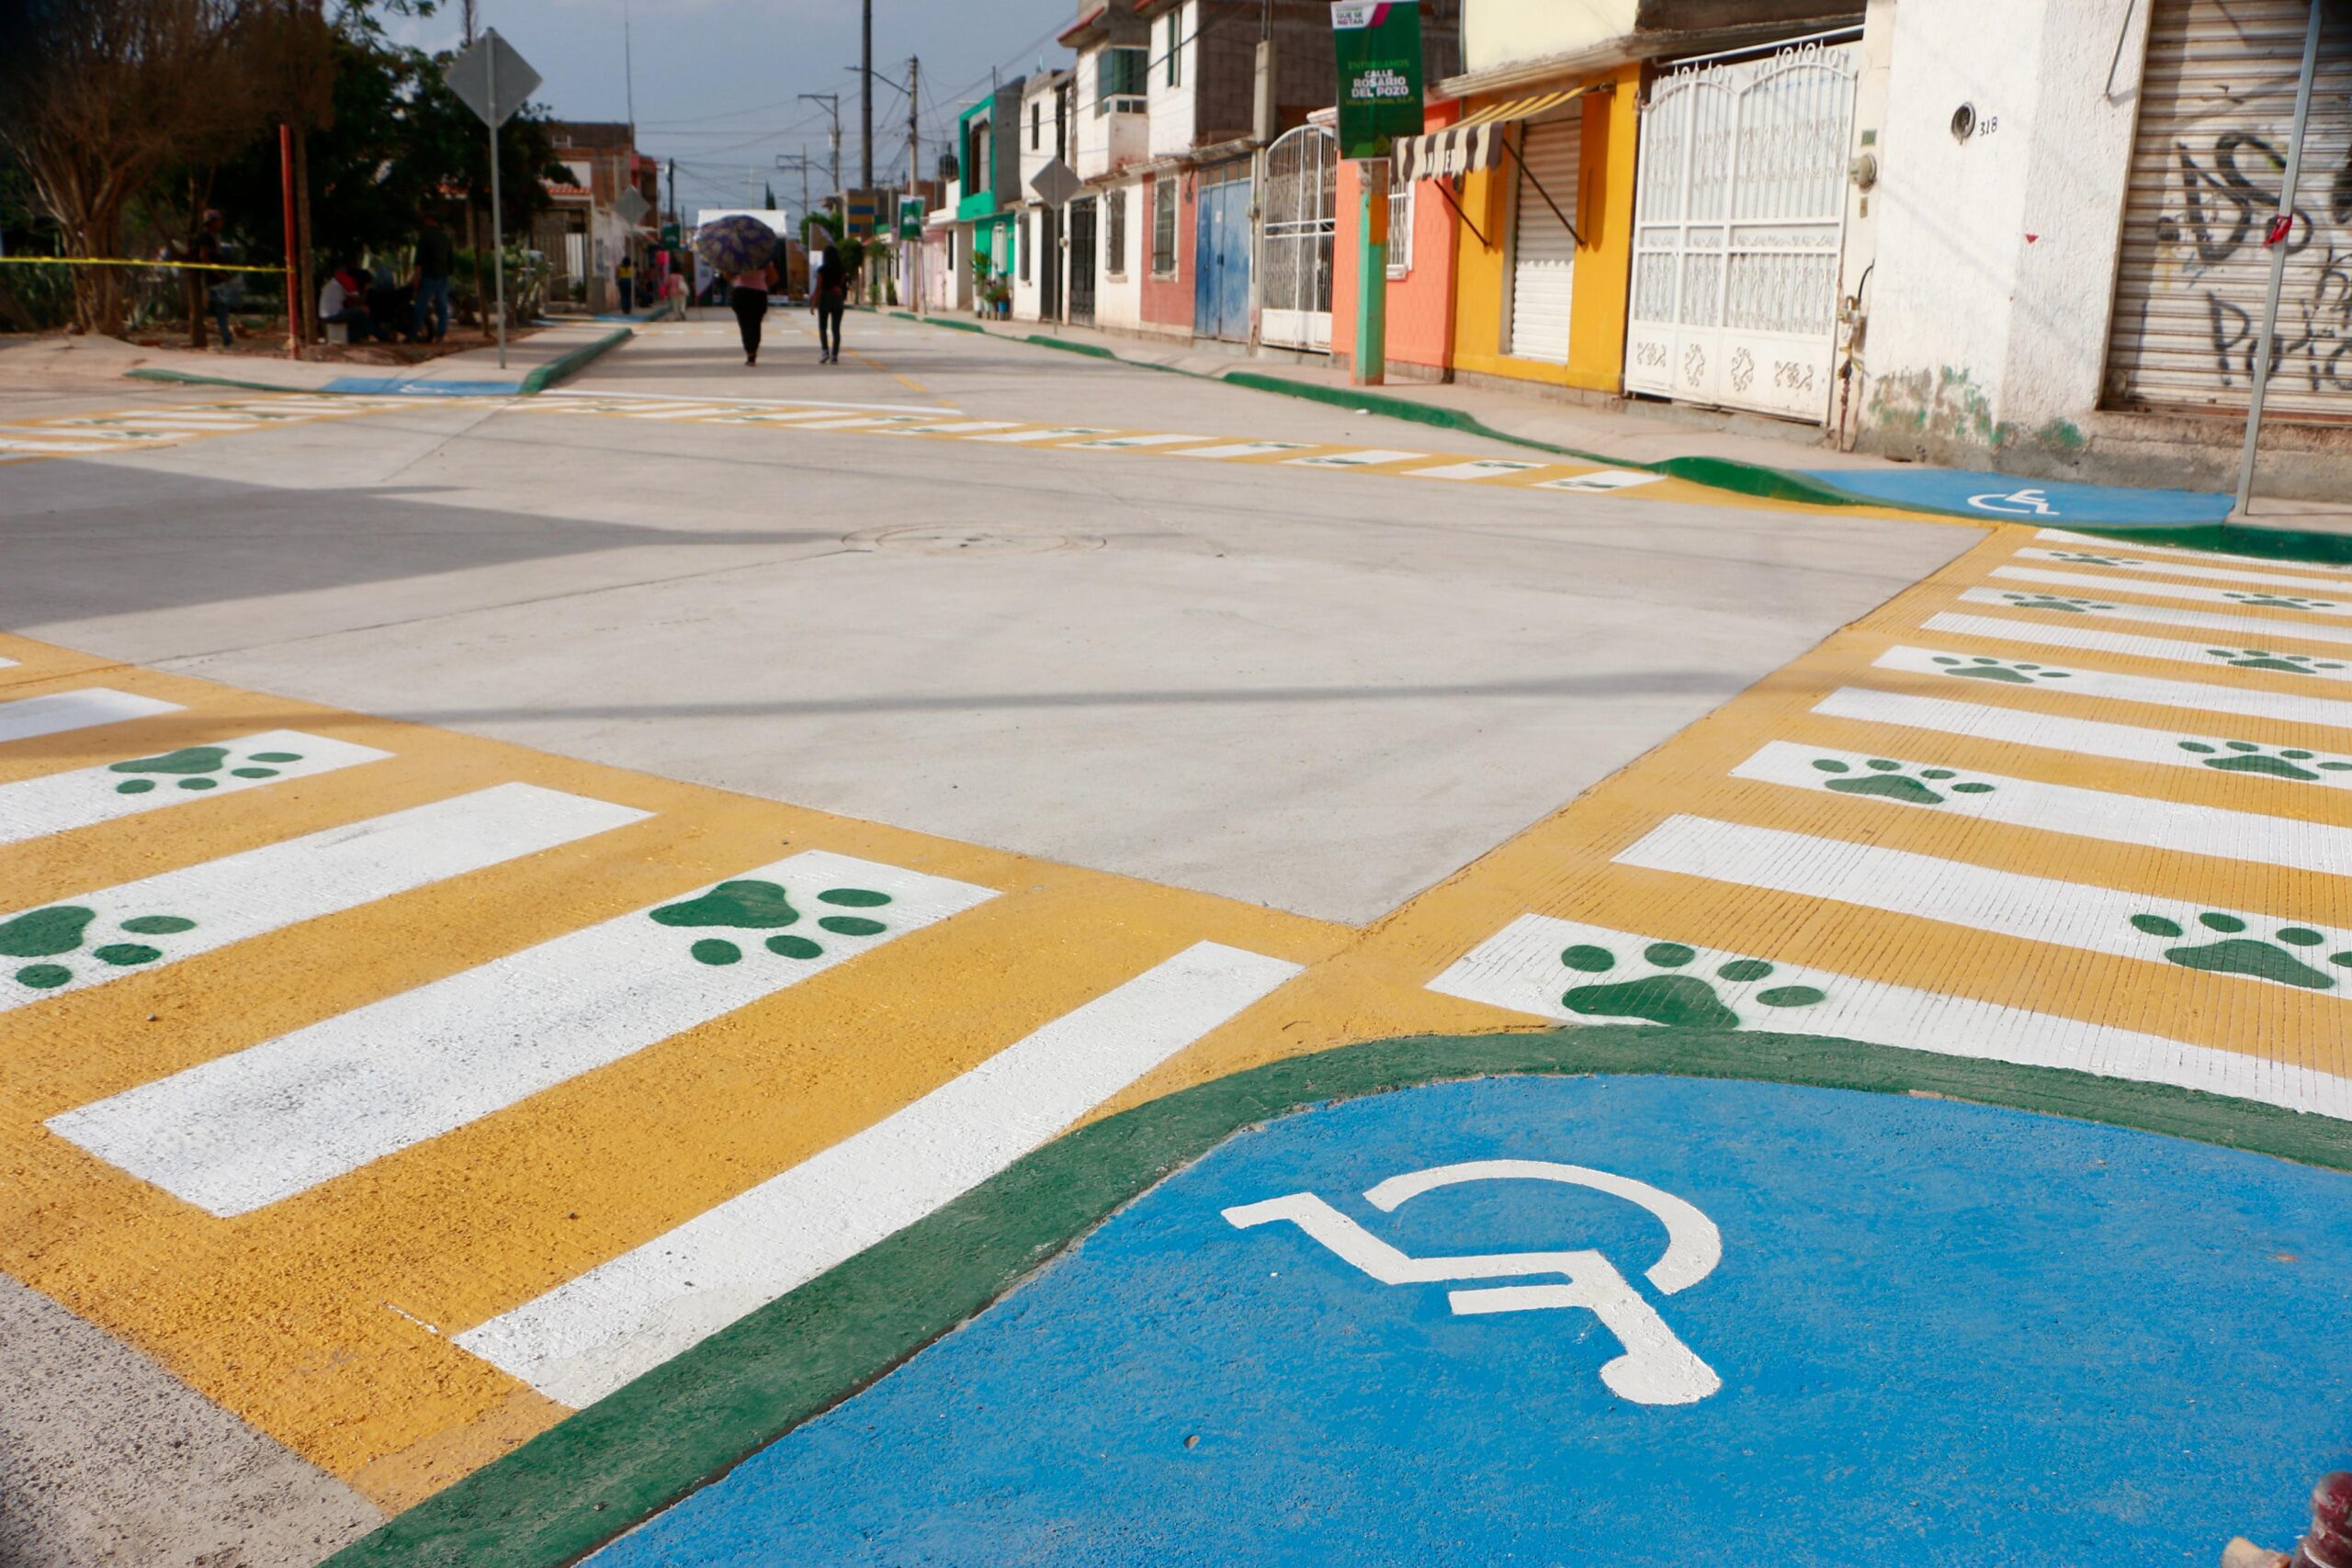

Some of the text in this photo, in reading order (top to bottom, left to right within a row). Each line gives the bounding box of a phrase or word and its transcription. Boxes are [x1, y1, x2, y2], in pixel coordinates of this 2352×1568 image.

[1364, 69, 1394, 77] CALLE
[1353, 76, 1406, 88] ROSARIO
[1351, 85, 1409, 98] DEL POZO
[1980, 116, 1998, 136] 318
